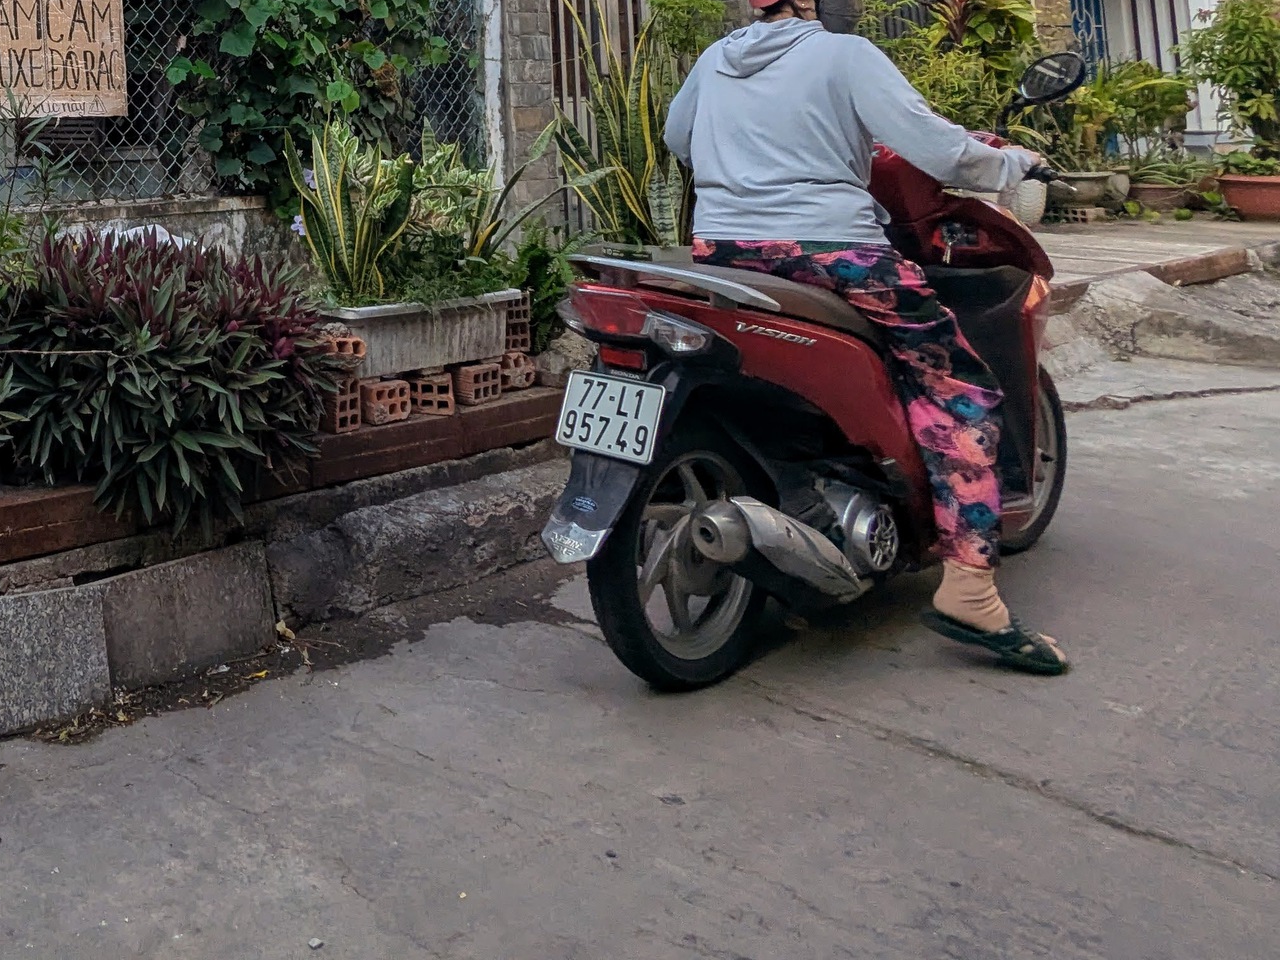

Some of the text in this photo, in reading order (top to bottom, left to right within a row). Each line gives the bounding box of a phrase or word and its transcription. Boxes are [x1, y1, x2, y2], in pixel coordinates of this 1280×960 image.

[12, 47, 44, 87] XE
[83, 42, 121, 91] RÁC
[610, 369, 640, 380] HONDA
[578, 378, 645, 420] 77-L1
[562, 409, 649, 456] 957.49
